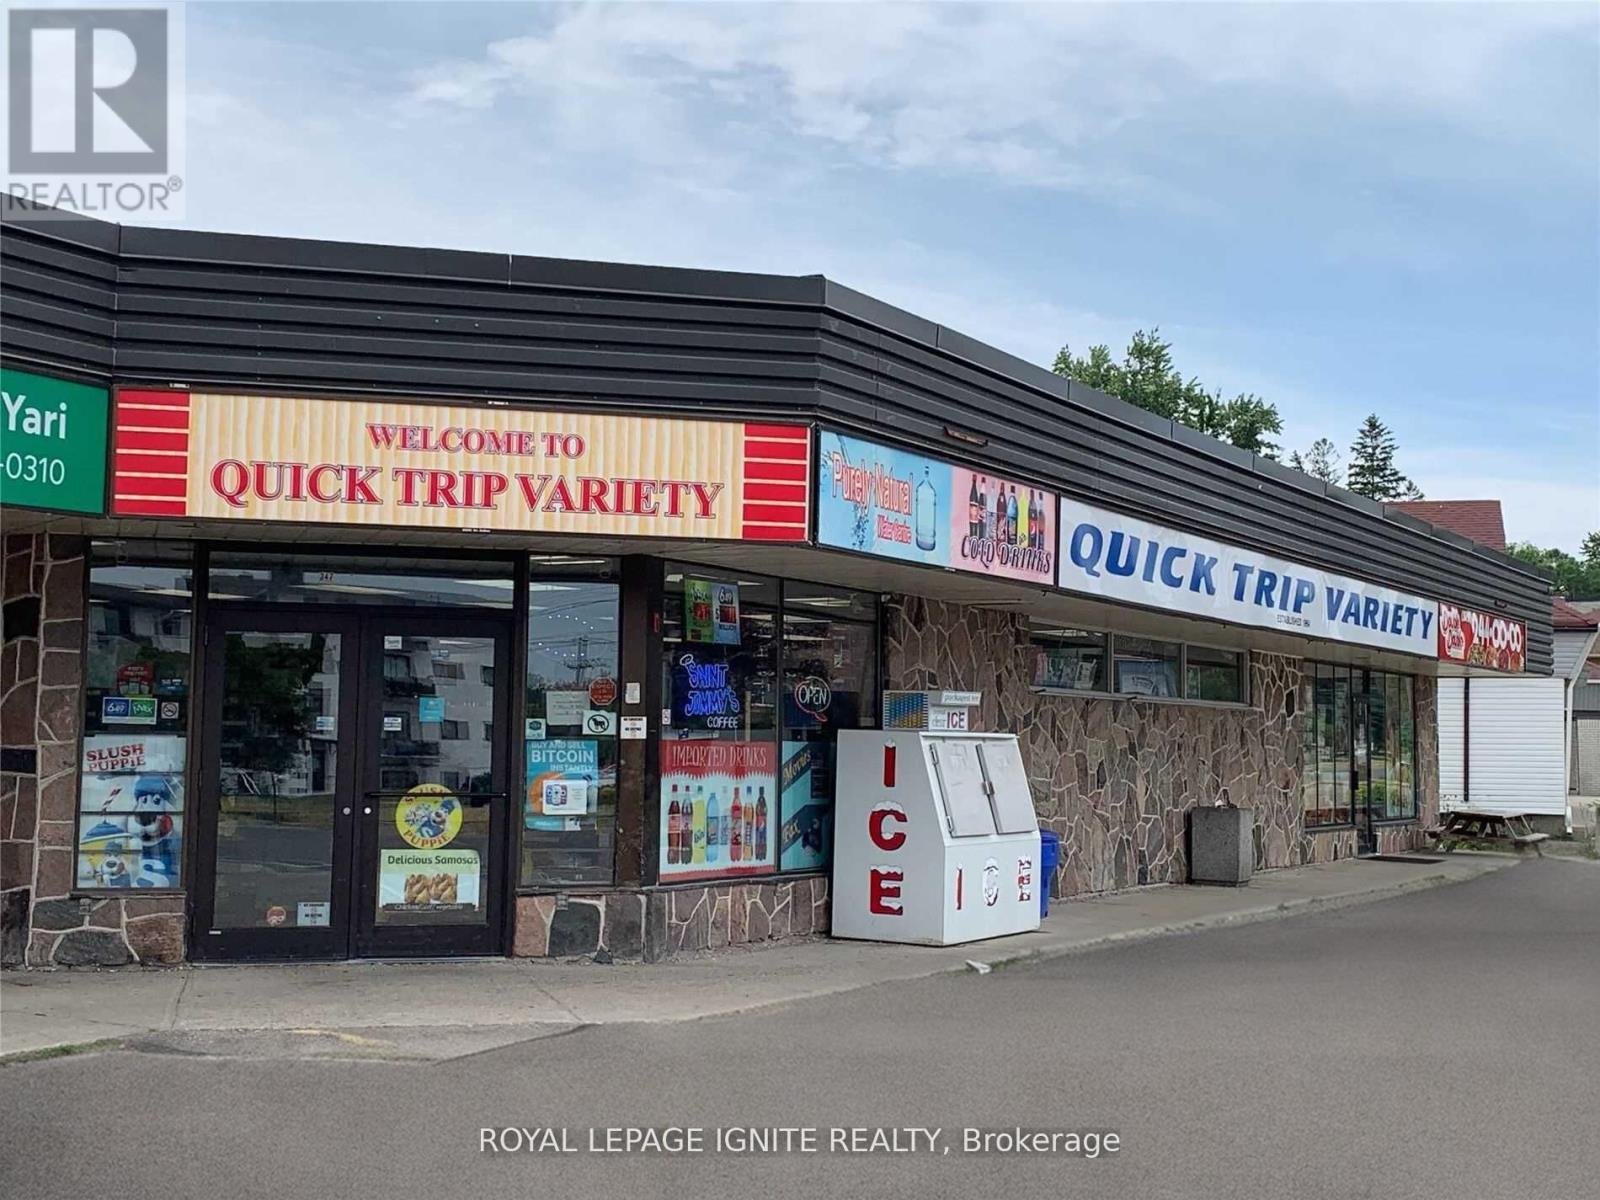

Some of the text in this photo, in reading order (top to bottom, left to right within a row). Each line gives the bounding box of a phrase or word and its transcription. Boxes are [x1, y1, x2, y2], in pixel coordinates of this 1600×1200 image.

[1, 391, 68, 440] Yari
[365, 423, 585, 459] WELCOME TO
[210, 458, 724, 519] QUICK TRIP VARIETY
[832, 451, 913, 516] Purely Natural
[961, 535, 1051, 574] COLD DRINKS
[1070, 523, 1434, 640] QUICK TRIP VARIETY
[688, 663, 729, 688] SAINT
[799, 684, 827, 705] OPEN
[707, 716, 739, 728] COFFEE
[947, 711, 965, 729] ICE
[86, 743, 144, 762] SLUSH
[531, 741, 548, 749] BUY
[89, 756, 146, 772] PUPPIE
[531, 750, 594, 763] BITCOIN
[672, 745, 767, 768] IMPORTED DRINKS
[550, 764, 594, 772] INSTANTLY
[869, 738, 908, 916] ICE
[403, 830, 449, 848] PUPPIE
[388, 854, 479, 866] Delicious Samosas
